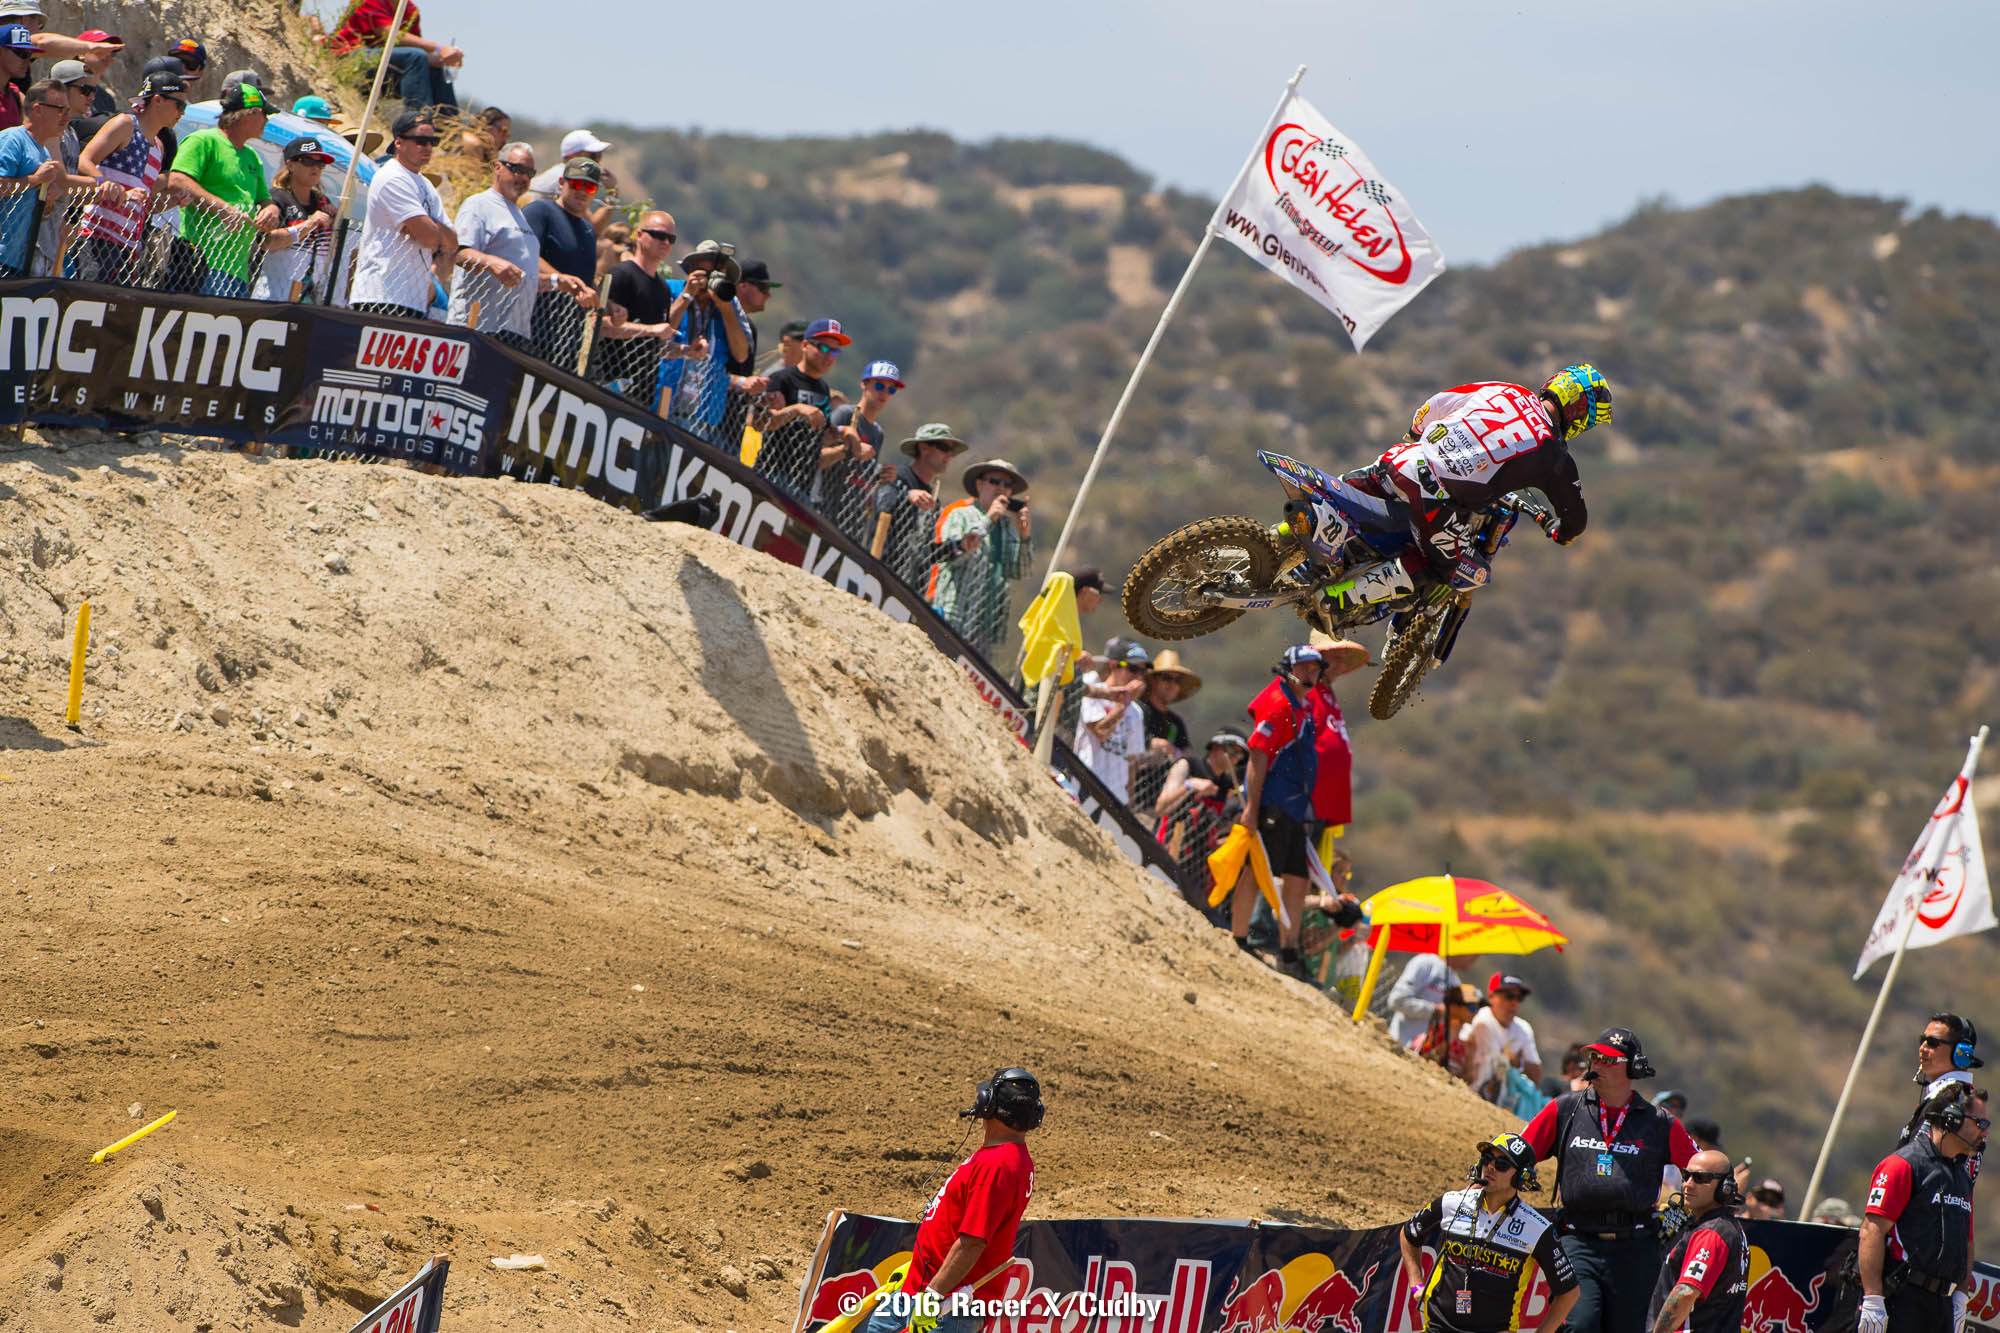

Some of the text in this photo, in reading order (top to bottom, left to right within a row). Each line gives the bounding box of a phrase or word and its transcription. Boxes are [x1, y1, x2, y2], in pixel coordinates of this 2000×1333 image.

[1281, 138, 1393, 258] GLEN HELEN
[0, 297, 288, 392] MC KMC
[361, 331, 466, 378] LUCAS OIL
[14, 385, 276, 424] EELS WHEELS
[382, 376, 435, 397] PRO
[508, 373, 645, 494] KMC
[1503, 387, 1550, 440] PEICK
[309, 425, 478, 467] CHAMPIOSHIP
[1322, 513, 1343, 543] 28
